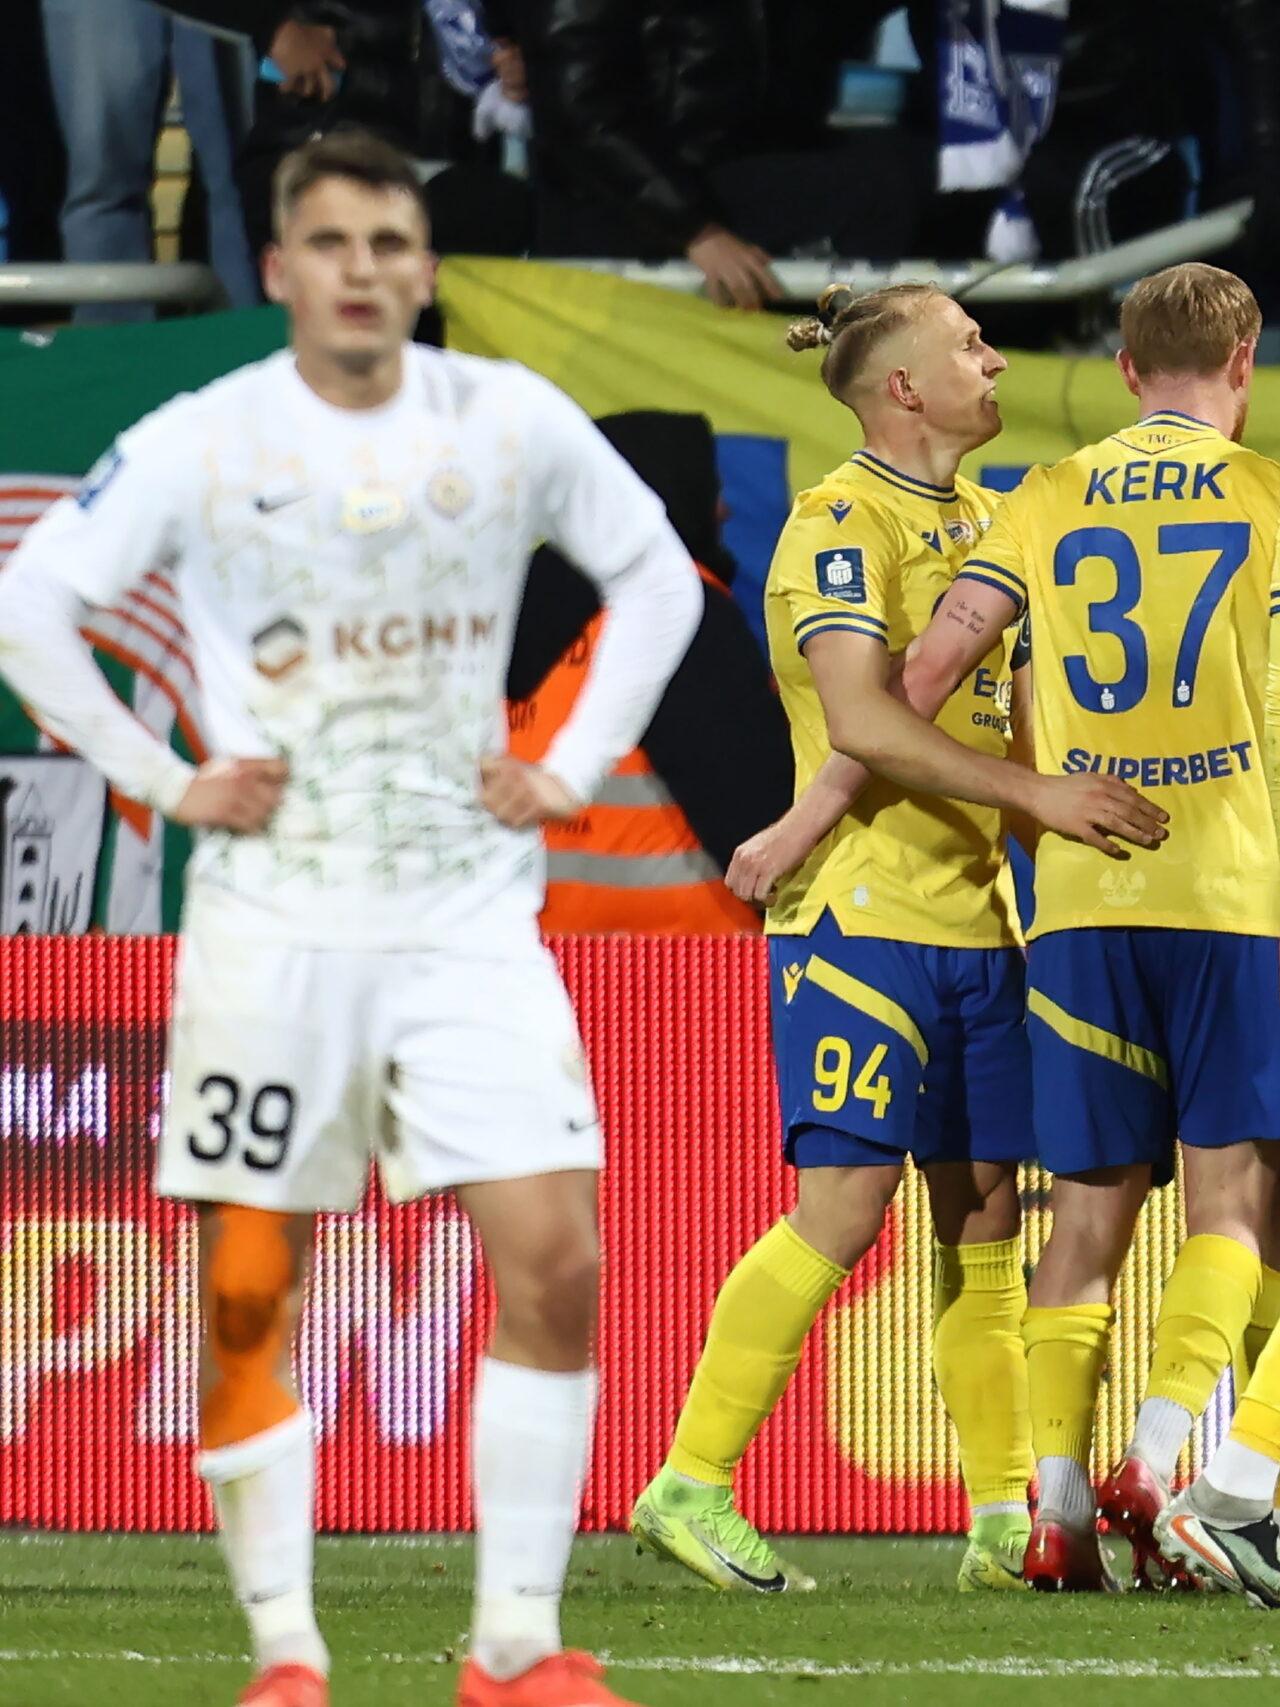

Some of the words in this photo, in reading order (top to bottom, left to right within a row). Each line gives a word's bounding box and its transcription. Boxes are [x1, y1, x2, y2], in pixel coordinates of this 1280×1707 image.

[1084, 460, 1229, 506] KERK
[1054, 522, 1251, 714] 37
[1062, 740, 1251, 787] SUPERBET
[812, 1036, 892, 1119] 94
[187, 1073, 297, 1173] 39
